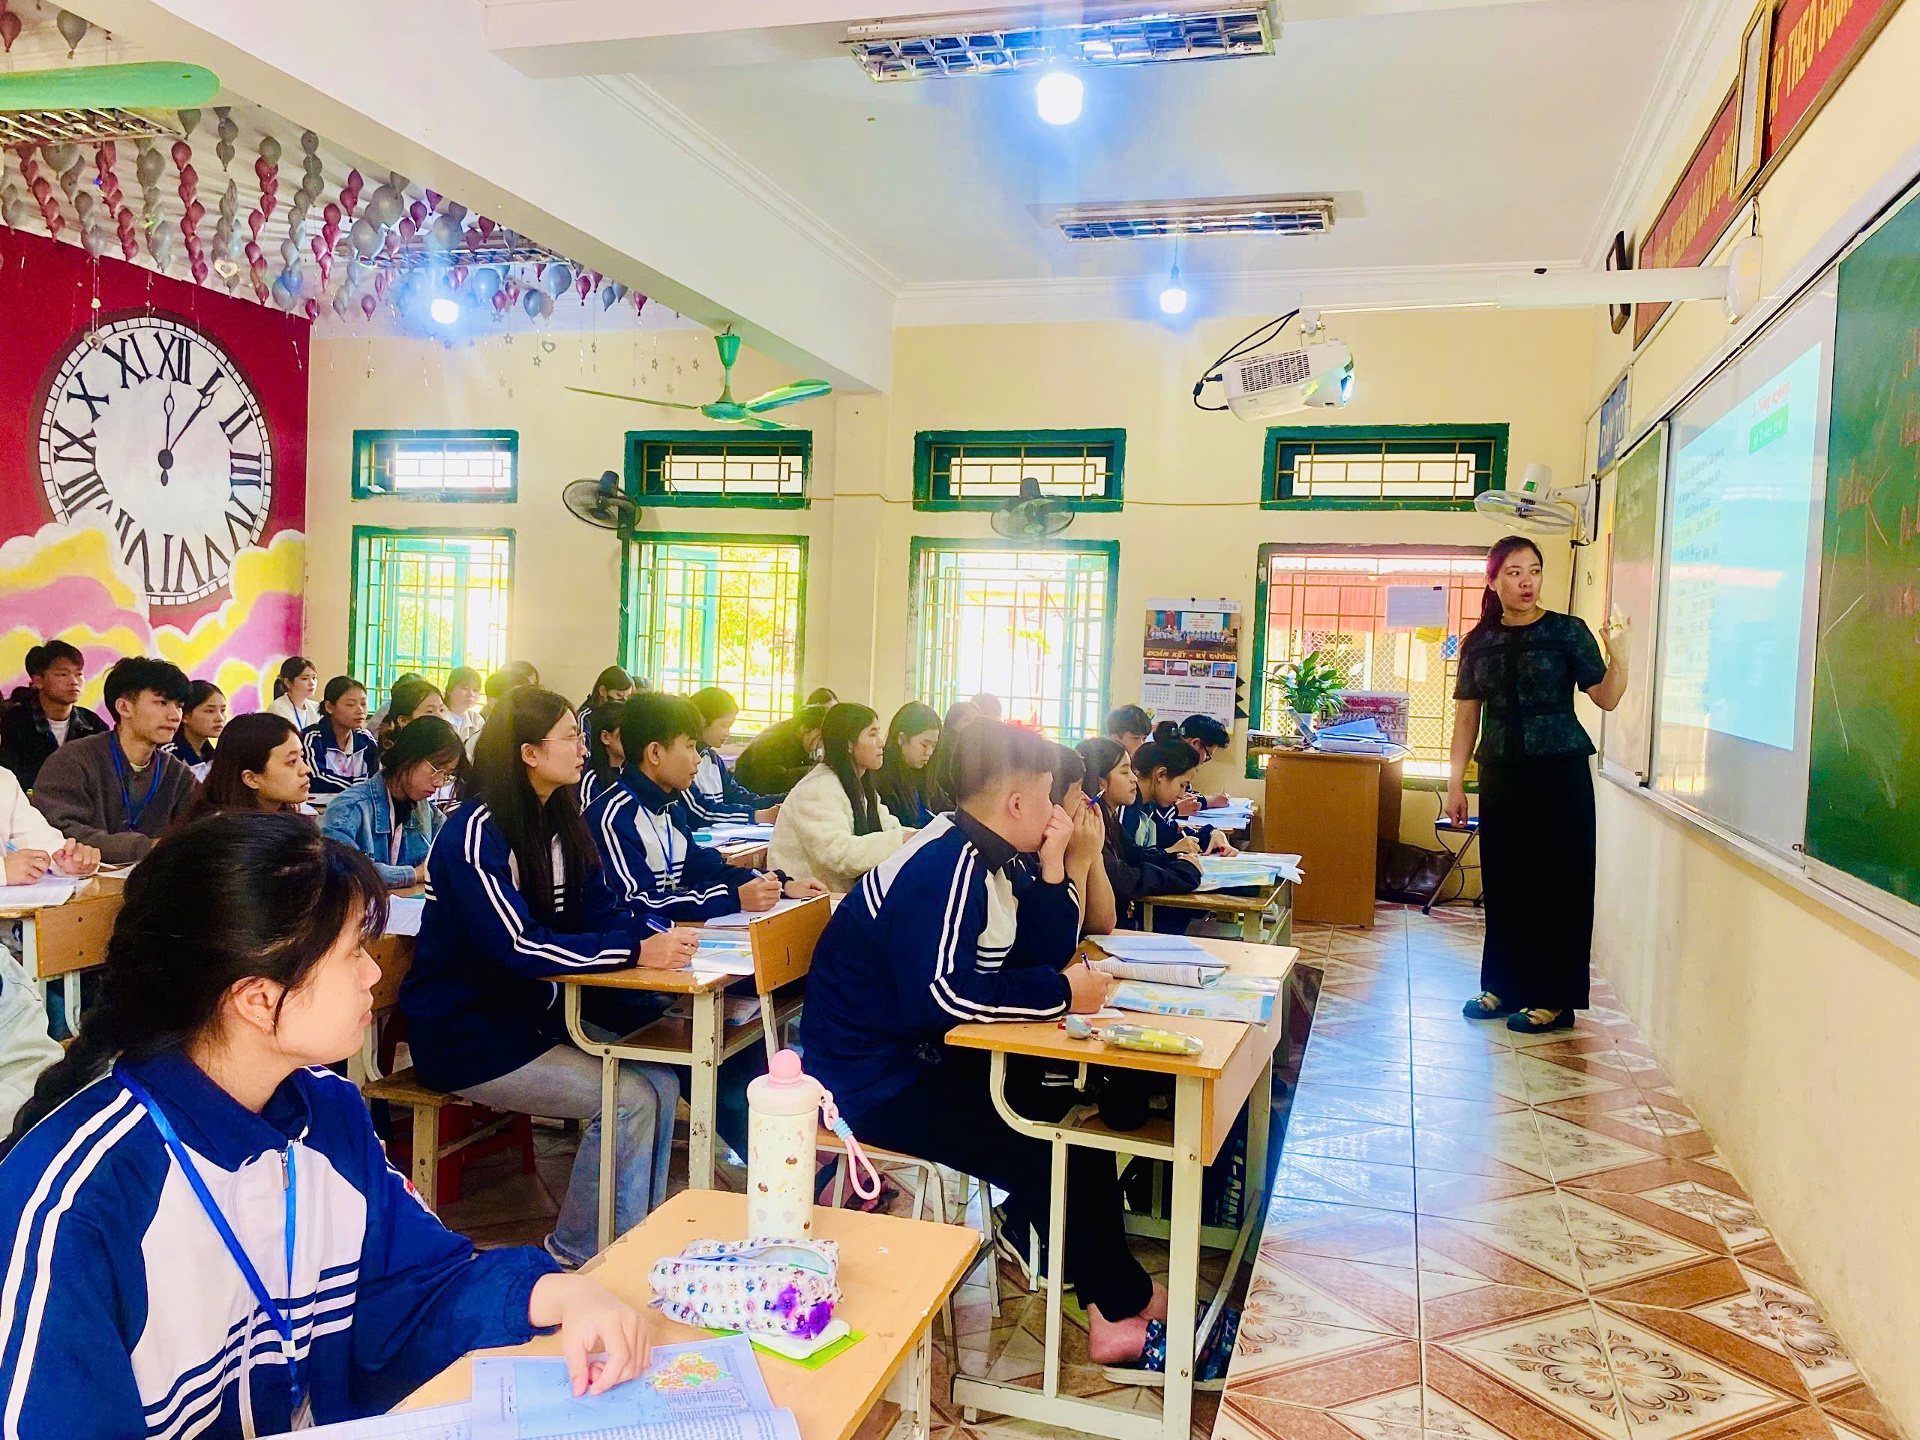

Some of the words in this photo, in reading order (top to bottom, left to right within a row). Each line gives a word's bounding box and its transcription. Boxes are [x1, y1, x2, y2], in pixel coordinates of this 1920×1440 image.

[102, 333, 153, 389] XI
[153, 331, 191, 385] XII
[67, 371, 110, 423] X
[53, 420, 97, 465] IX
[218, 401, 254, 444] II
[229, 449, 263, 490] III
[1217, 603, 1238, 611] 2026
